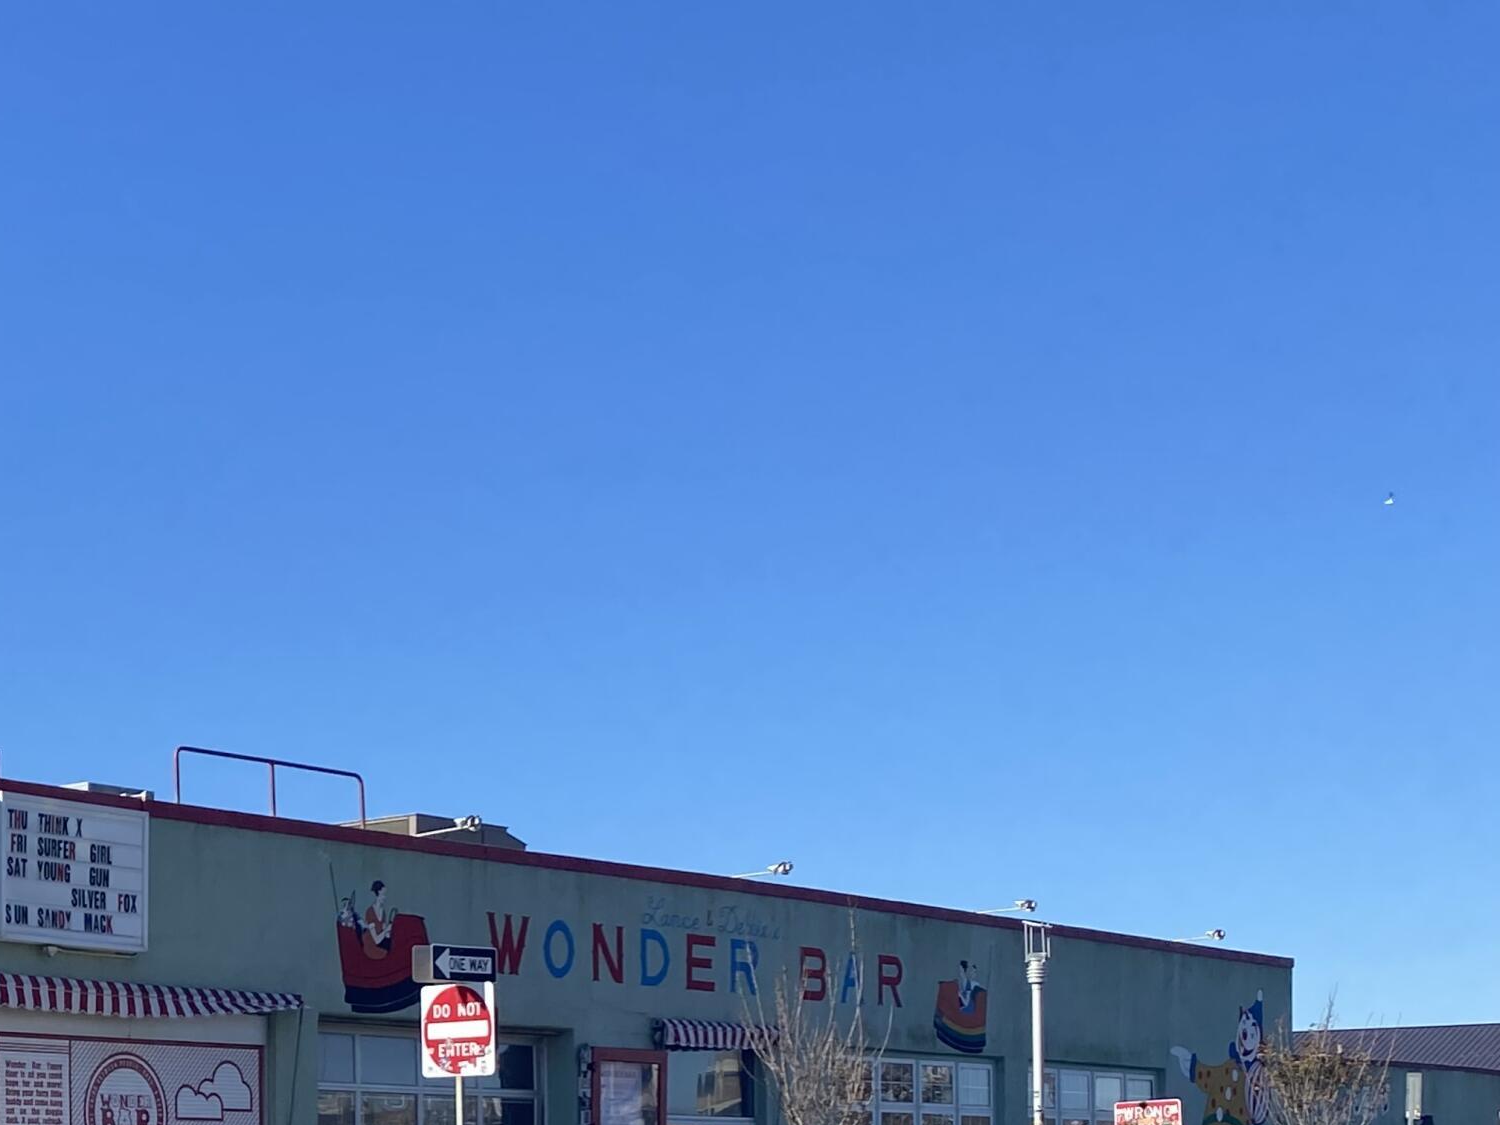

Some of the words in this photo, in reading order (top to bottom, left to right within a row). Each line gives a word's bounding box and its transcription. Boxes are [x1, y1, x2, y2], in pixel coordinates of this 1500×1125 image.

[8, 808, 28, 830] THU
[38, 813, 70, 836] THINK
[76, 818, 83, 838] X
[11, 833, 27, 854] FRI
[37, 837, 76, 861] SURFER
[90, 844, 112, 865] GIRL
[7, 857, 27, 878] SAT
[37, 860, 71, 883] YOUNG
[89, 867, 109, 888] GUN
[71, 888, 106, 910] SILVER
[118, 893, 137, 914] FOX
[5, 904, 28, 925] SUN
[37, 908, 72, 930] SANDY
[84, 913, 113, 934] MACK
[449, 957, 467, 972] ONE
[469, 958, 489, 972] WAY
[486, 910, 760, 996] WONDER
[800, 945, 903, 1008] BAR
[432, 1004, 451, 1019] DO
[457, 1002, 481, 1018] NOT
[438, 1042, 479, 1058] ENTER
[100, 1092, 152, 1110] WONDER
[1124, 1104, 1172, 1120] WRONG
